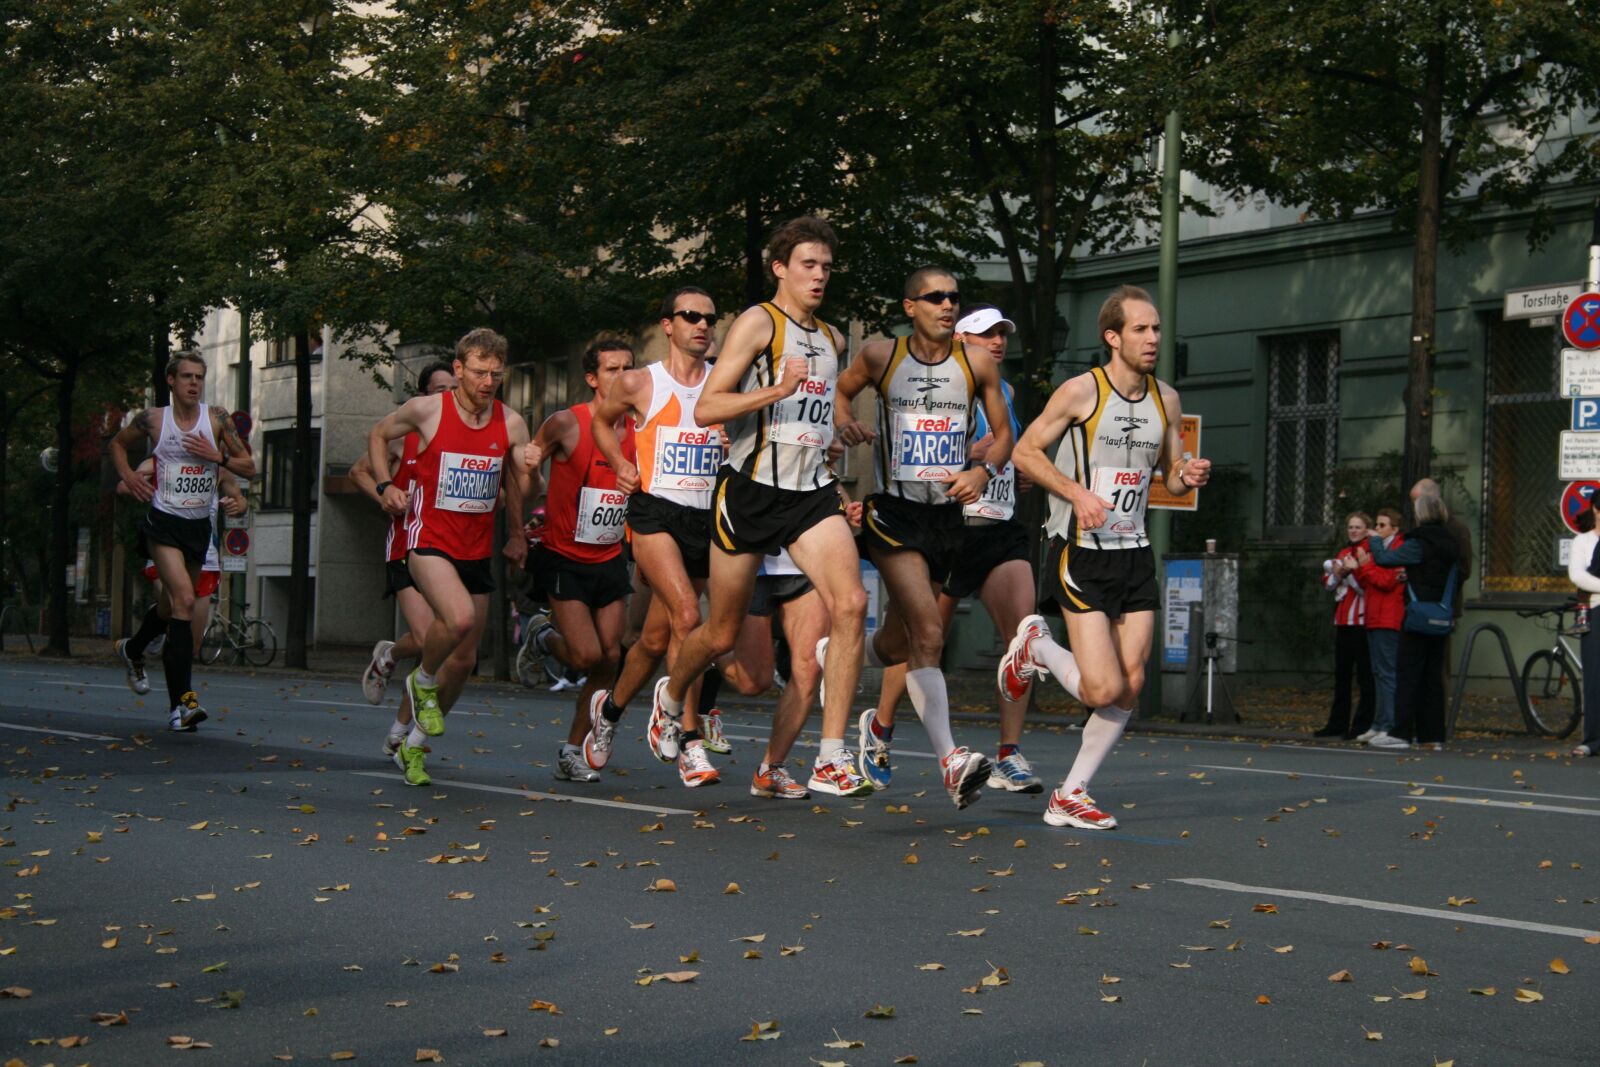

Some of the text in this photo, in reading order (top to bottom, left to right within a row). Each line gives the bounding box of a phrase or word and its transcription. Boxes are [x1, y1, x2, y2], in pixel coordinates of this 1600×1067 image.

[1522, 291, 1569, 309] Torstraße
[797, 397, 832, 426] 102
[898, 396, 920, 409] lauf
[1114, 416, 1149, 424] BROOKS
[1579, 400, 1598, 428] P
[901, 432, 964, 465] PARCHI
[1105, 435, 1123, 449] lauf
[663, 445, 720, 475] SEILER
[175, 477, 213, 494] 33882
[1110, 488, 1144, 513] 101
